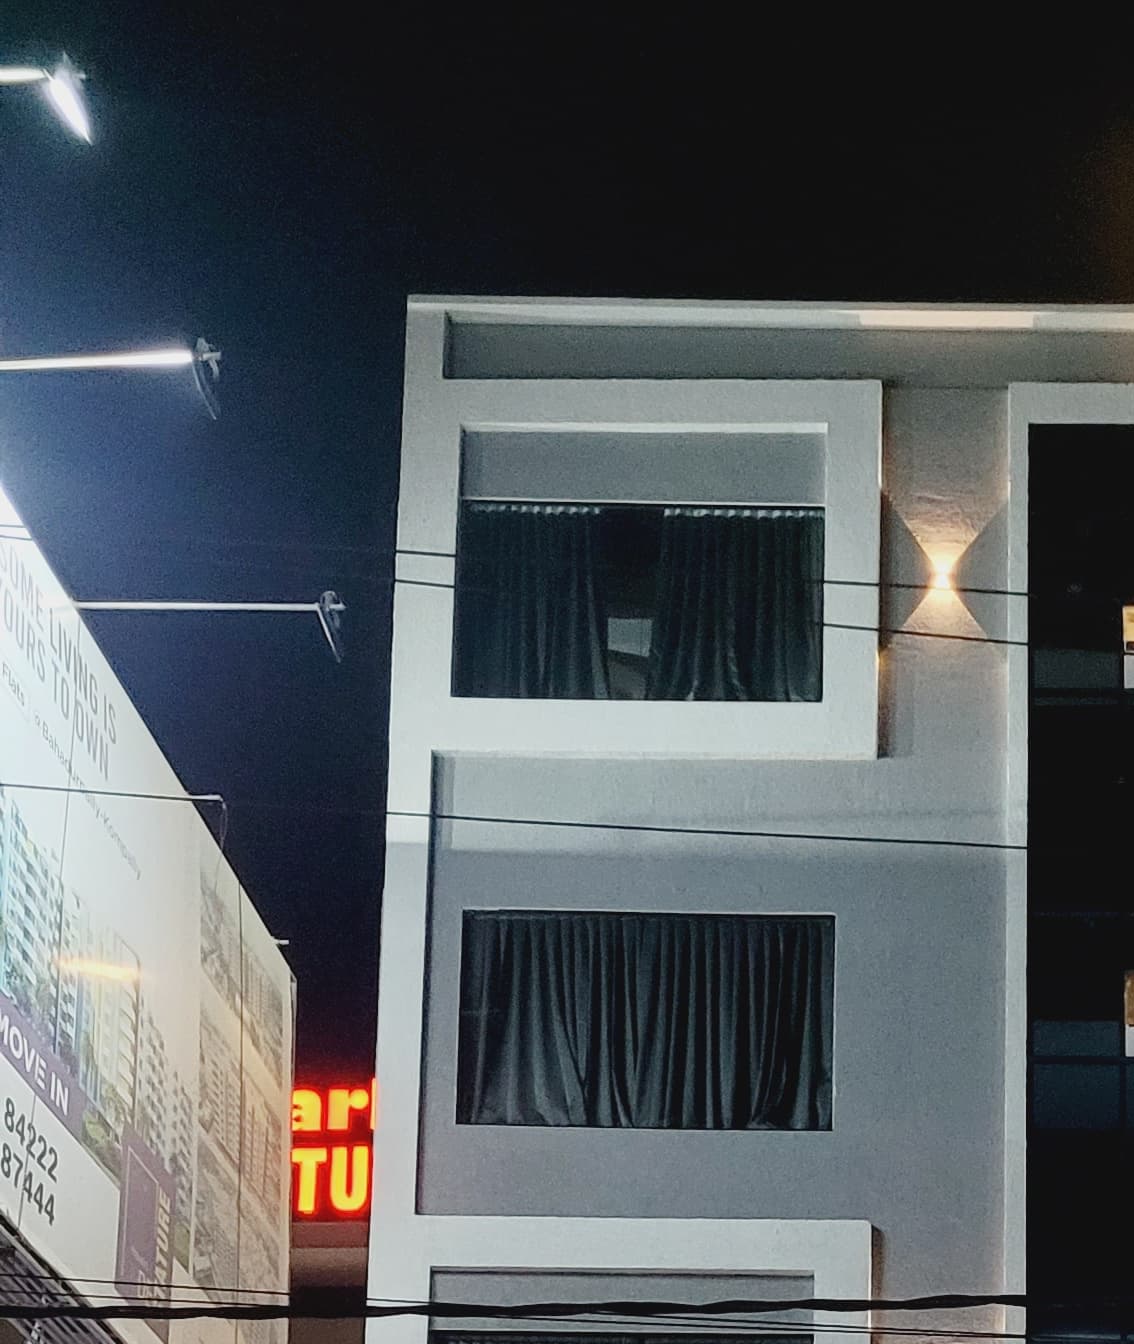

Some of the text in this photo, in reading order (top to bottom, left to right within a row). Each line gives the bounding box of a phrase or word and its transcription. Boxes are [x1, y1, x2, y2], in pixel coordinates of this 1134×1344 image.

[0, 575, 109, 782] OURS TO OWN
[50, 608, 97, 716] LIVING
[103, 695, 116, 745] IS
[51, 1071, 69, 1117] IN
[292, 1078, 377, 1131] ar
[292, 1146, 369, 1214] TU
